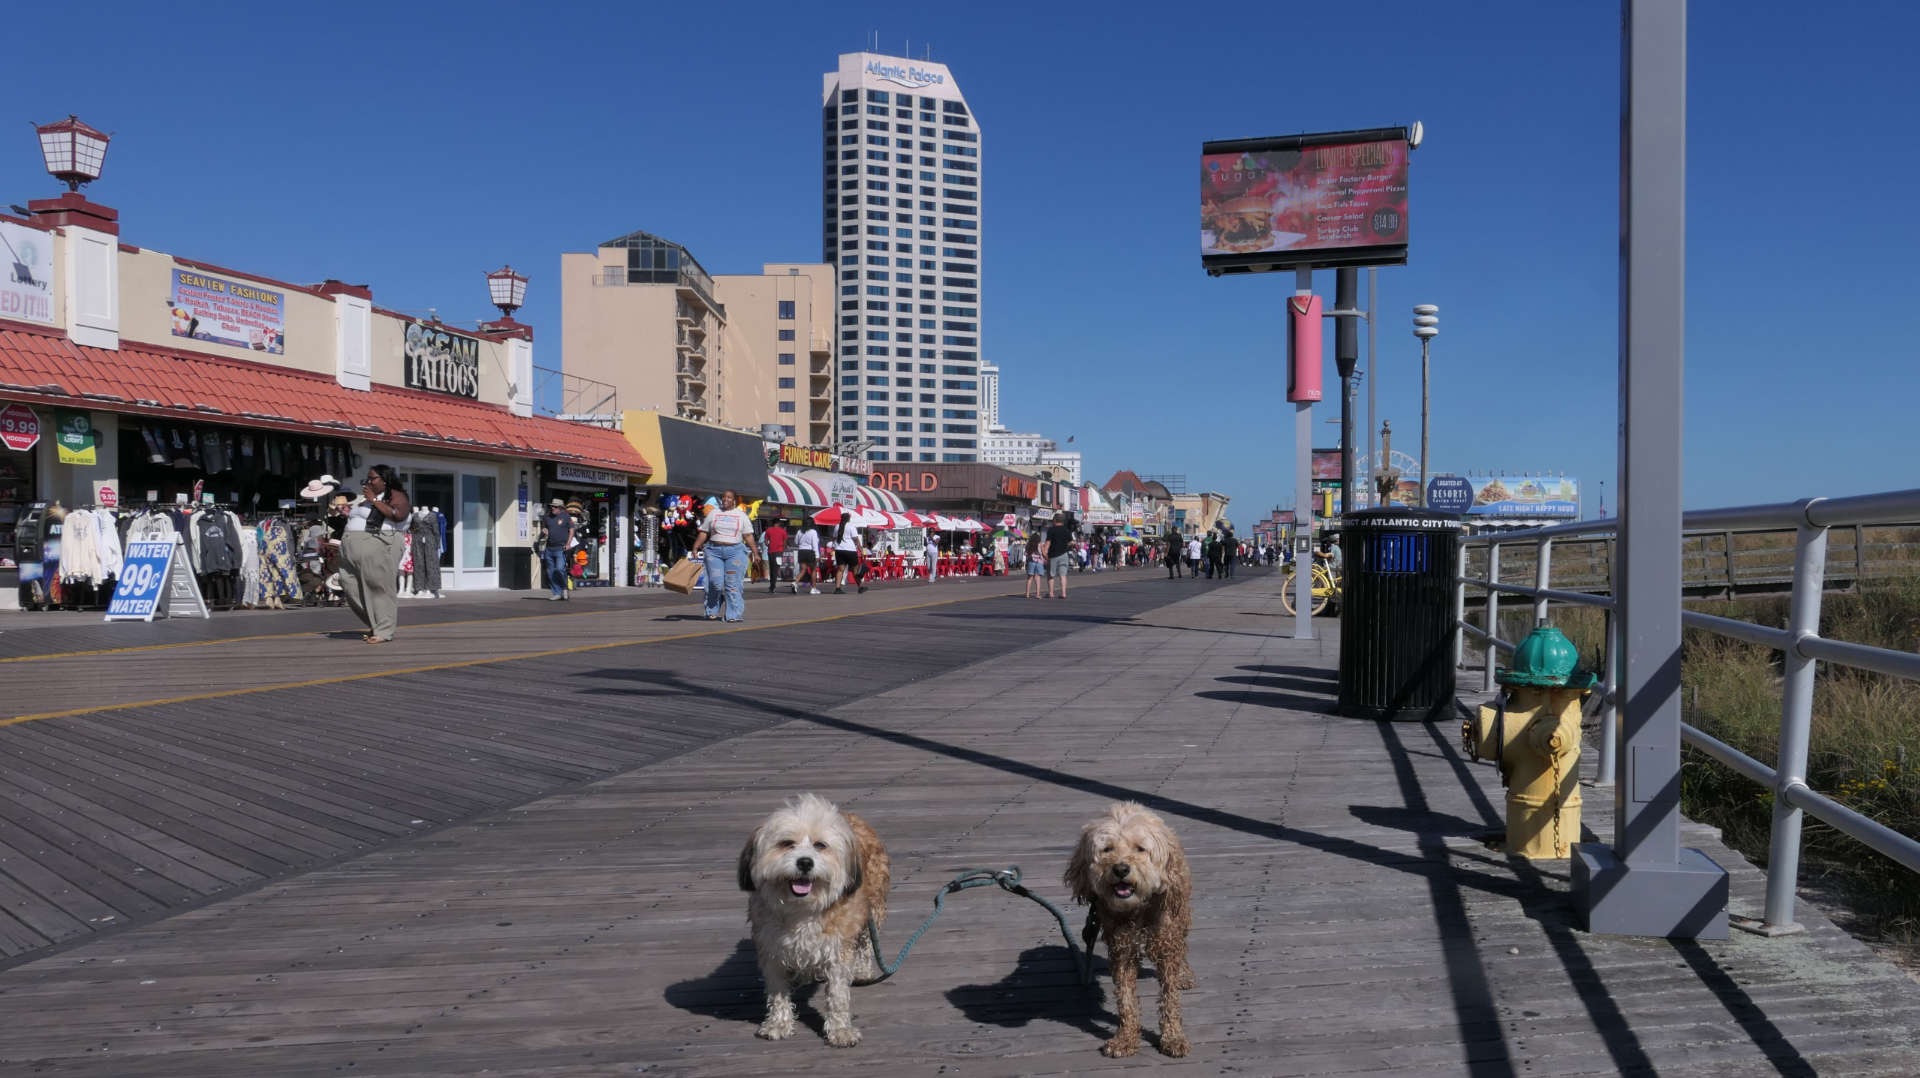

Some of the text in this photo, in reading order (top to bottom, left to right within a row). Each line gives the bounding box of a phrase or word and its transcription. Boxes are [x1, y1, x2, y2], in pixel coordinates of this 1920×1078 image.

[865, 60, 944, 84] Atlantic Palace
[1367, 174, 1393, 183] Burger
[1385, 185, 1406, 193] Pizza
[10, 271, 48, 291] Lottery
[180, 273, 280, 305] SEAVIEW FASHIONS
[406, 323, 477, 367] OCEAN
[406, 341, 478, 398] TATTOOS
[784, 446, 813, 467] FUNNEL
[813, 450, 832, 469] CAKE
[868, 472, 938, 492] ORLD
[1432, 489, 1467, 498] RESORTS
[50, 524, 62, 534] AT
[1370, 519, 1419, 527] ATLANTIC
[1422, 520, 1443, 528] CITY
[128, 543, 170, 558] WATER
[119, 563, 160, 596] 99¢
[110, 599, 152, 613] WATER
